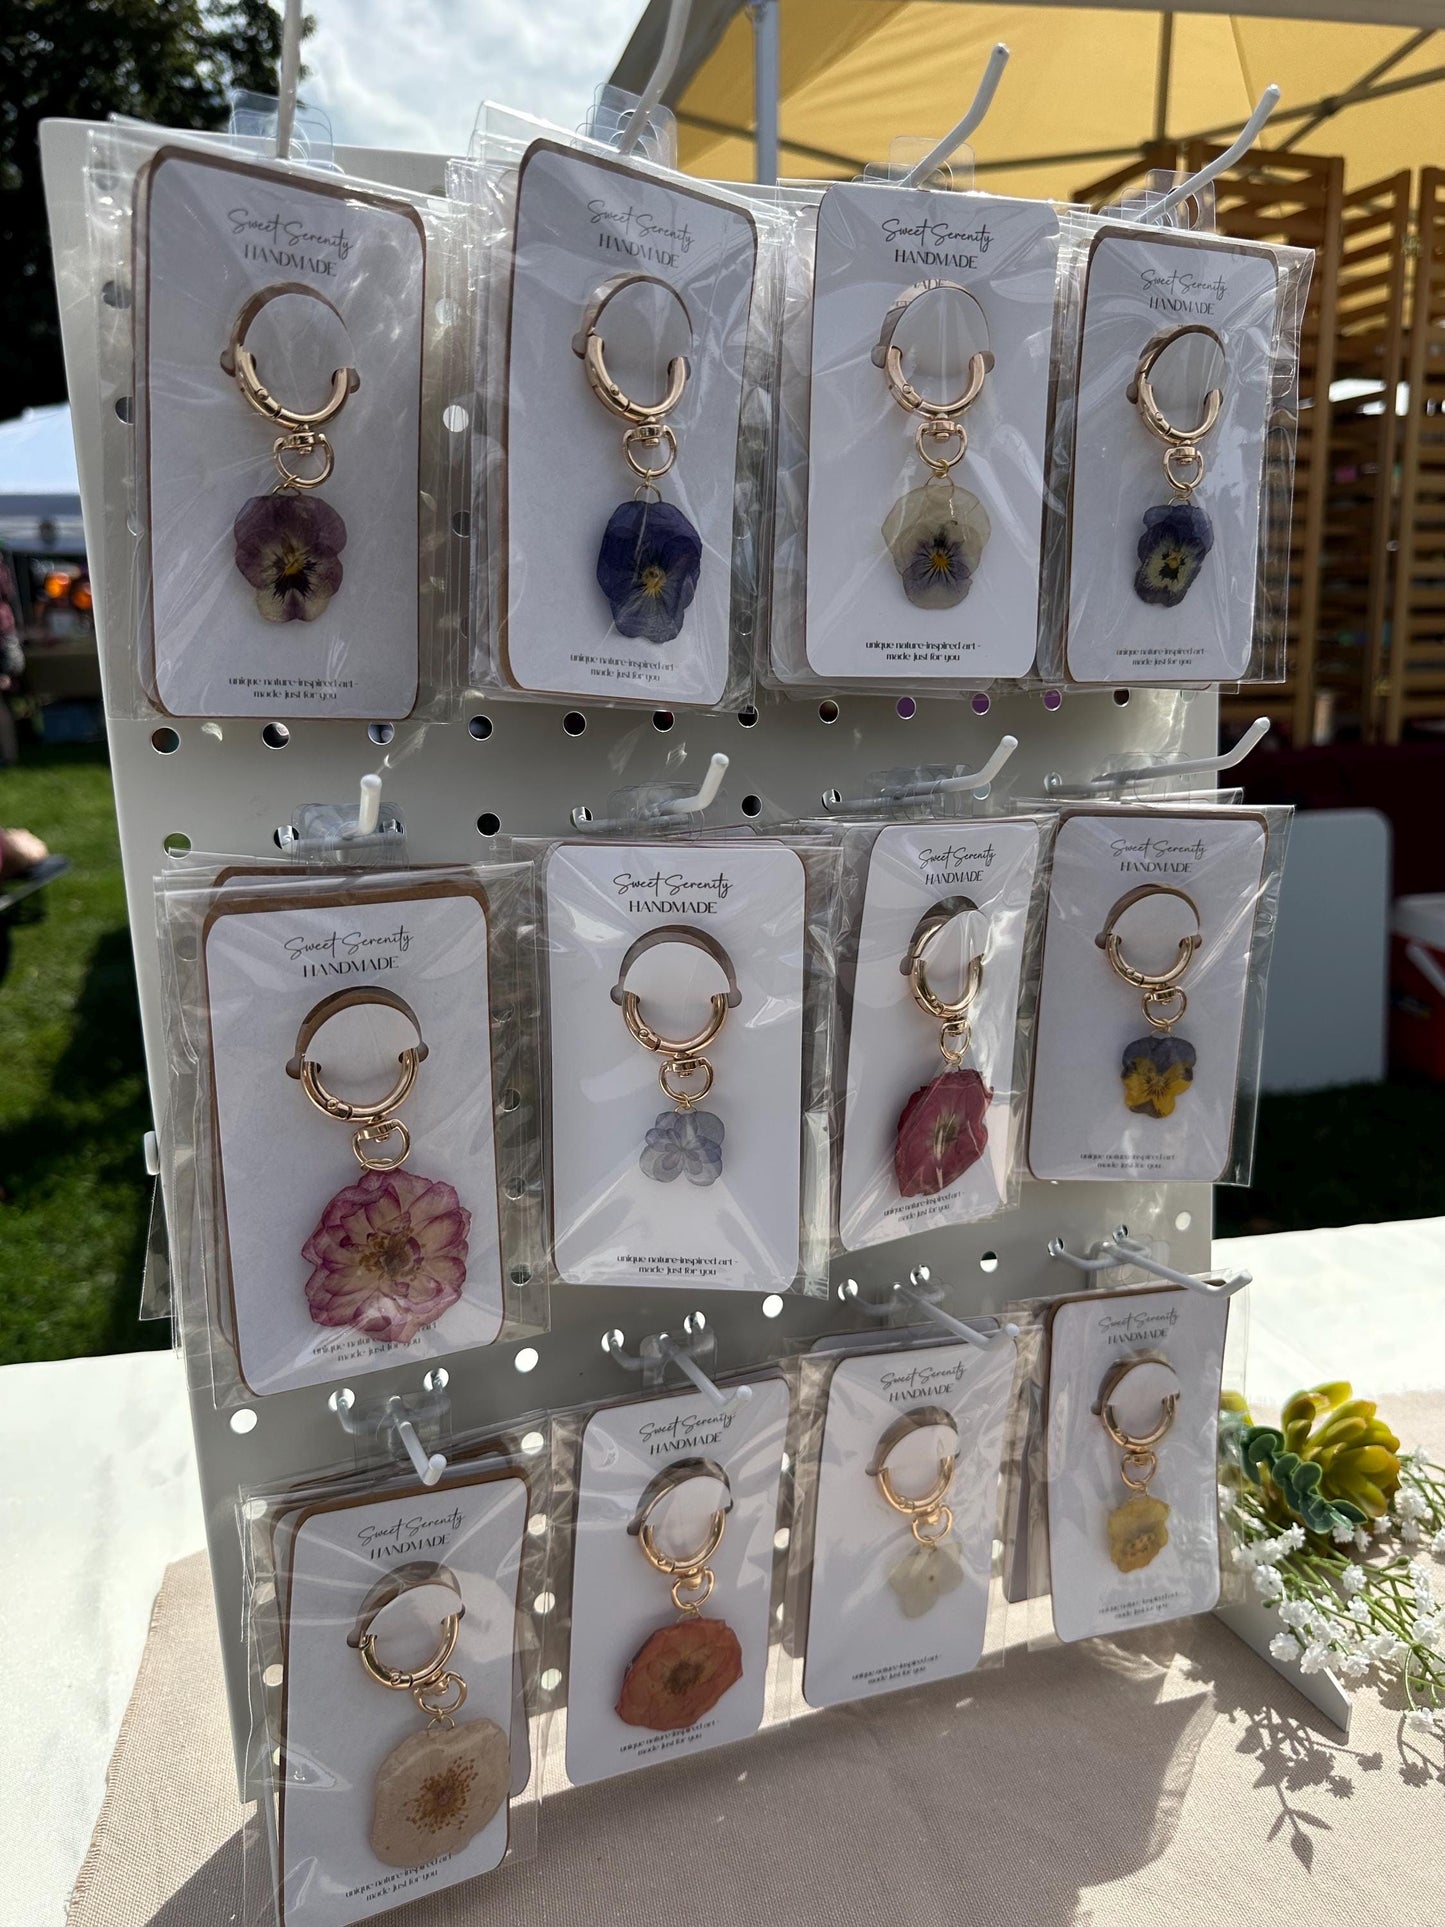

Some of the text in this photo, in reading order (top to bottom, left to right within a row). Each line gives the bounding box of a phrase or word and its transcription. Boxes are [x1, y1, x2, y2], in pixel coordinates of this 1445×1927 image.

[227, 208, 353, 260] Sweet Serenity
[587, 199, 695, 253] Sweet Serenity
[881, 218, 994, 253] Sweet Serenity
[244, 244, 337, 277] HANDMADE
[599, 233, 679, 268] HANDMADE
[895, 249, 978, 269] HANDMADE
[1141, 269, 1227, 301] Sweet Serenity
[1149, 296, 1215, 315] HANDMADE
[865, 641, 894, 650] unique
[886, 652, 911, 660] made
[913, 652, 928, 661] just
[919, 843, 996, 869] Sweet Serenity
[1110, 838, 1207, 860] Sweet Serenity
[925, 870, 984, 885] HANDMADE
[1120, 861, 1192, 873] HANDMADE
[613, 872, 733, 898] Sweet Serenity
[629, 900, 717, 914] HANDMADE
[284, 925, 414, 960] Sweet Serenity
[304, 956, 399, 977] HANDMADE
[617, 1255, 646, 1263] unique
[667, 1266, 682, 1274] just
[880, 1361, 967, 1390] Sweet Serenity
[889, 1383, 954, 1402] HANDMADE
[639, 1412, 736, 1441] Sweet Serenity
[650, 1432, 722, 1455] HANDMADE
[357, 1507, 466, 1546] Sweet Serenity
[371, 1533, 451, 1560] HANDMADE
